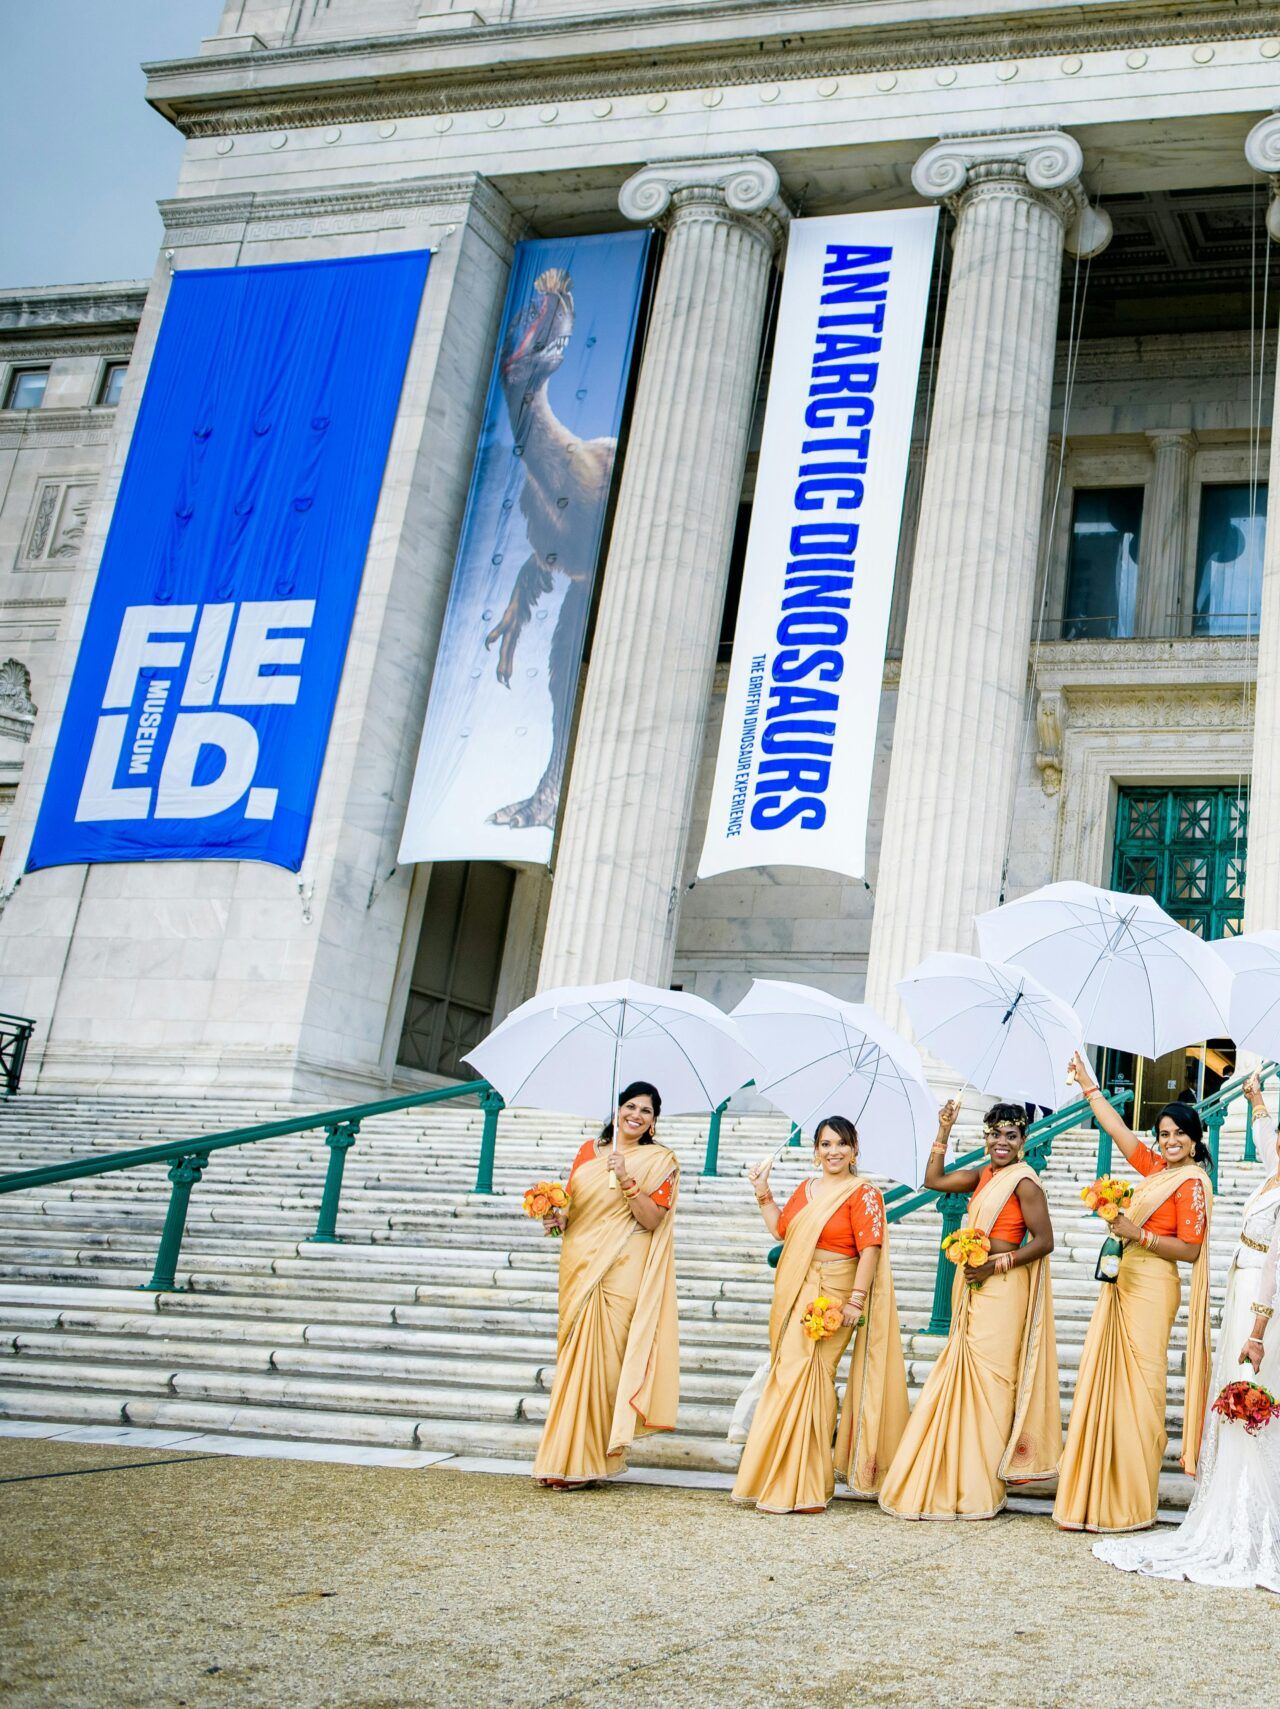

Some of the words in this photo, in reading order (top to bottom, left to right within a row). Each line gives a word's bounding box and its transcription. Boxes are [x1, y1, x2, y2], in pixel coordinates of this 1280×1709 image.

[794, 244, 893, 511] ANTARCTIC
[101, 600, 316, 709] FIE
[745, 674, 763, 717] GRIFFIN
[750, 522, 860, 831] DINOSAURS
[751, 654, 766, 674] THE
[74, 711, 279, 823] LD.
[129, 680, 171, 775] MUSEUM
[736, 717, 757, 773] DINOSAUR
[726, 773, 750, 839] EXPERIENCE
